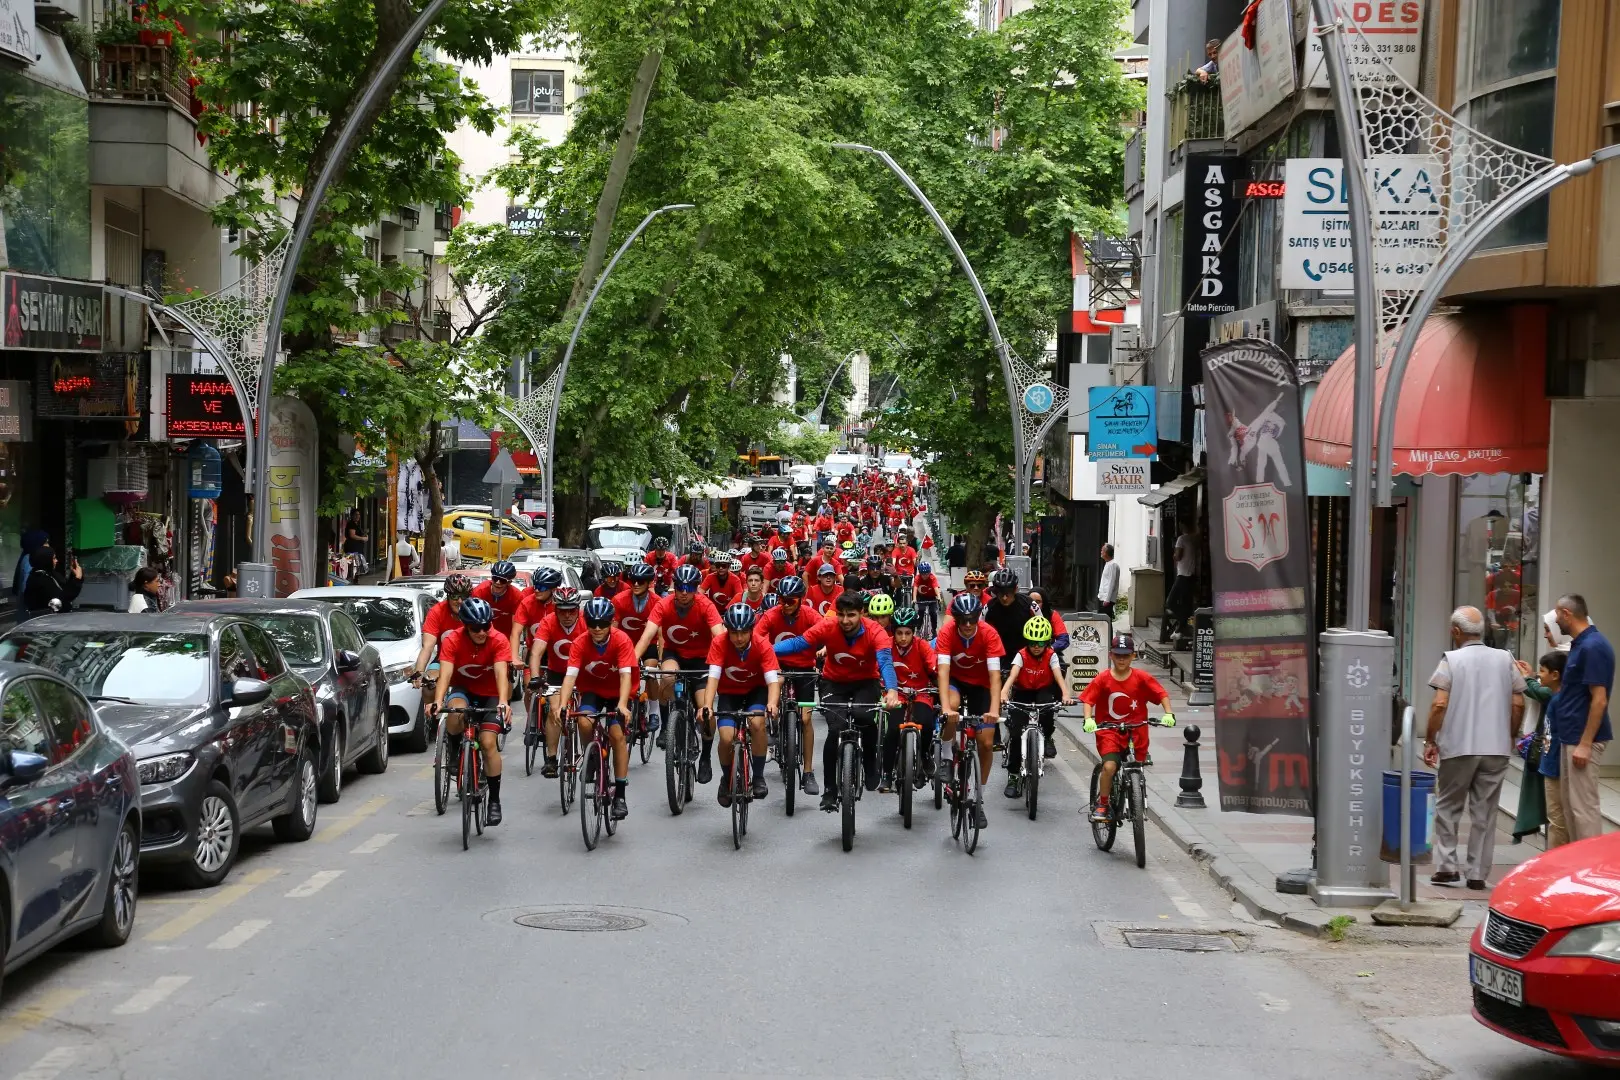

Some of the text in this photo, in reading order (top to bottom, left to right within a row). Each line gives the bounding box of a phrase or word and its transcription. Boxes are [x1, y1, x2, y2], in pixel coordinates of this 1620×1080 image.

[1200, 165, 1225, 297] ASGARD
[1289, 237, 1319, 249] SATIŞ
[1323, 237, 1337, 248] VE
[1187, 304, 1235, 313] Tattoo Piercing
[203, 400, 222, 413] VE
[1102, 472, 1142, 485] BAKIR
